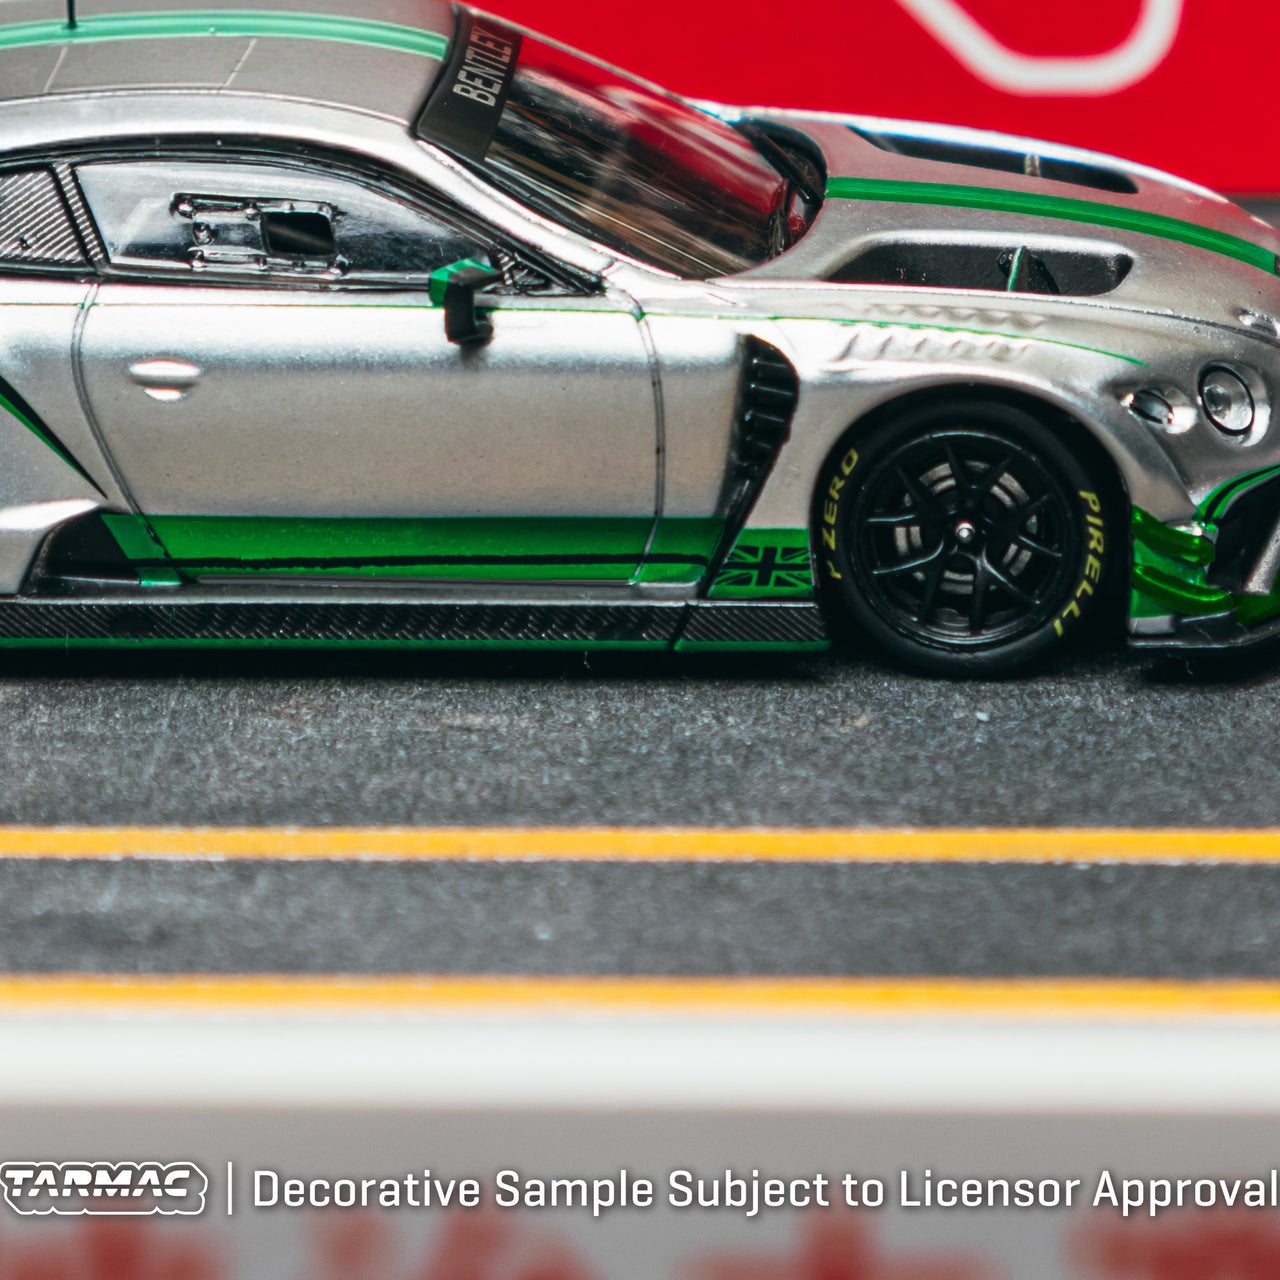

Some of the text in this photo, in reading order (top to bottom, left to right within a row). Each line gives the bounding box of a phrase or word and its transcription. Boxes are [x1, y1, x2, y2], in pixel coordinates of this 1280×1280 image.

[452, 26, 513, 107] BENTLEY
[822, 448, 859, 551] ZERO
[1053, 489, 1105, 637] PIRELLI
